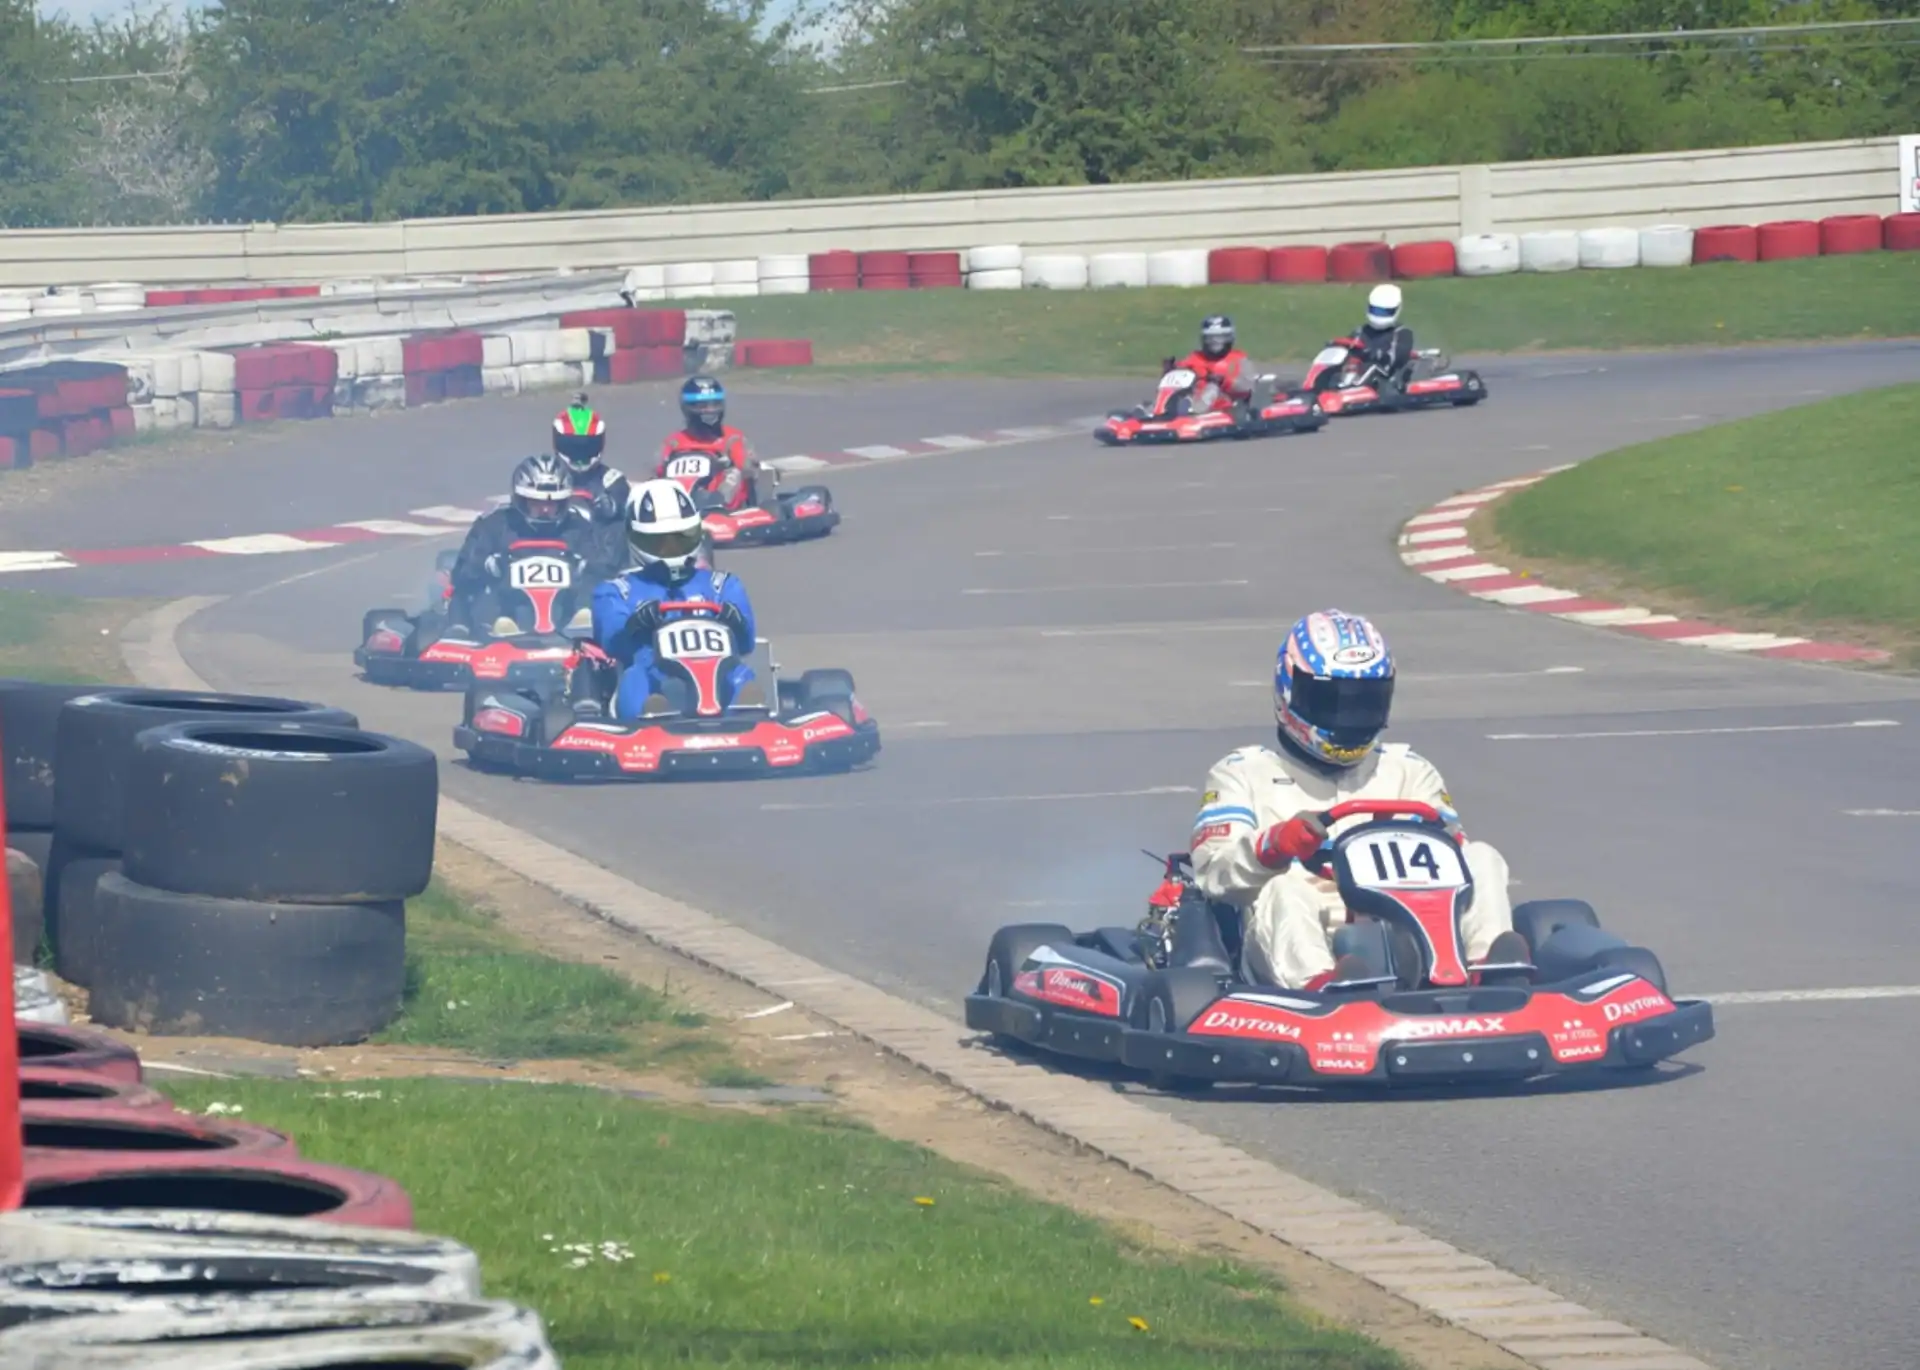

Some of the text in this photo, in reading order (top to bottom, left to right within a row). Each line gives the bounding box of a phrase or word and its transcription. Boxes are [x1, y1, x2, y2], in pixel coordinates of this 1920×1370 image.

[674, 459, 701, 475] 113
[518, 562, 564, 585] 120
[668, 628, 725, 655] 106
[1369, 841, 1440, 881] 114
